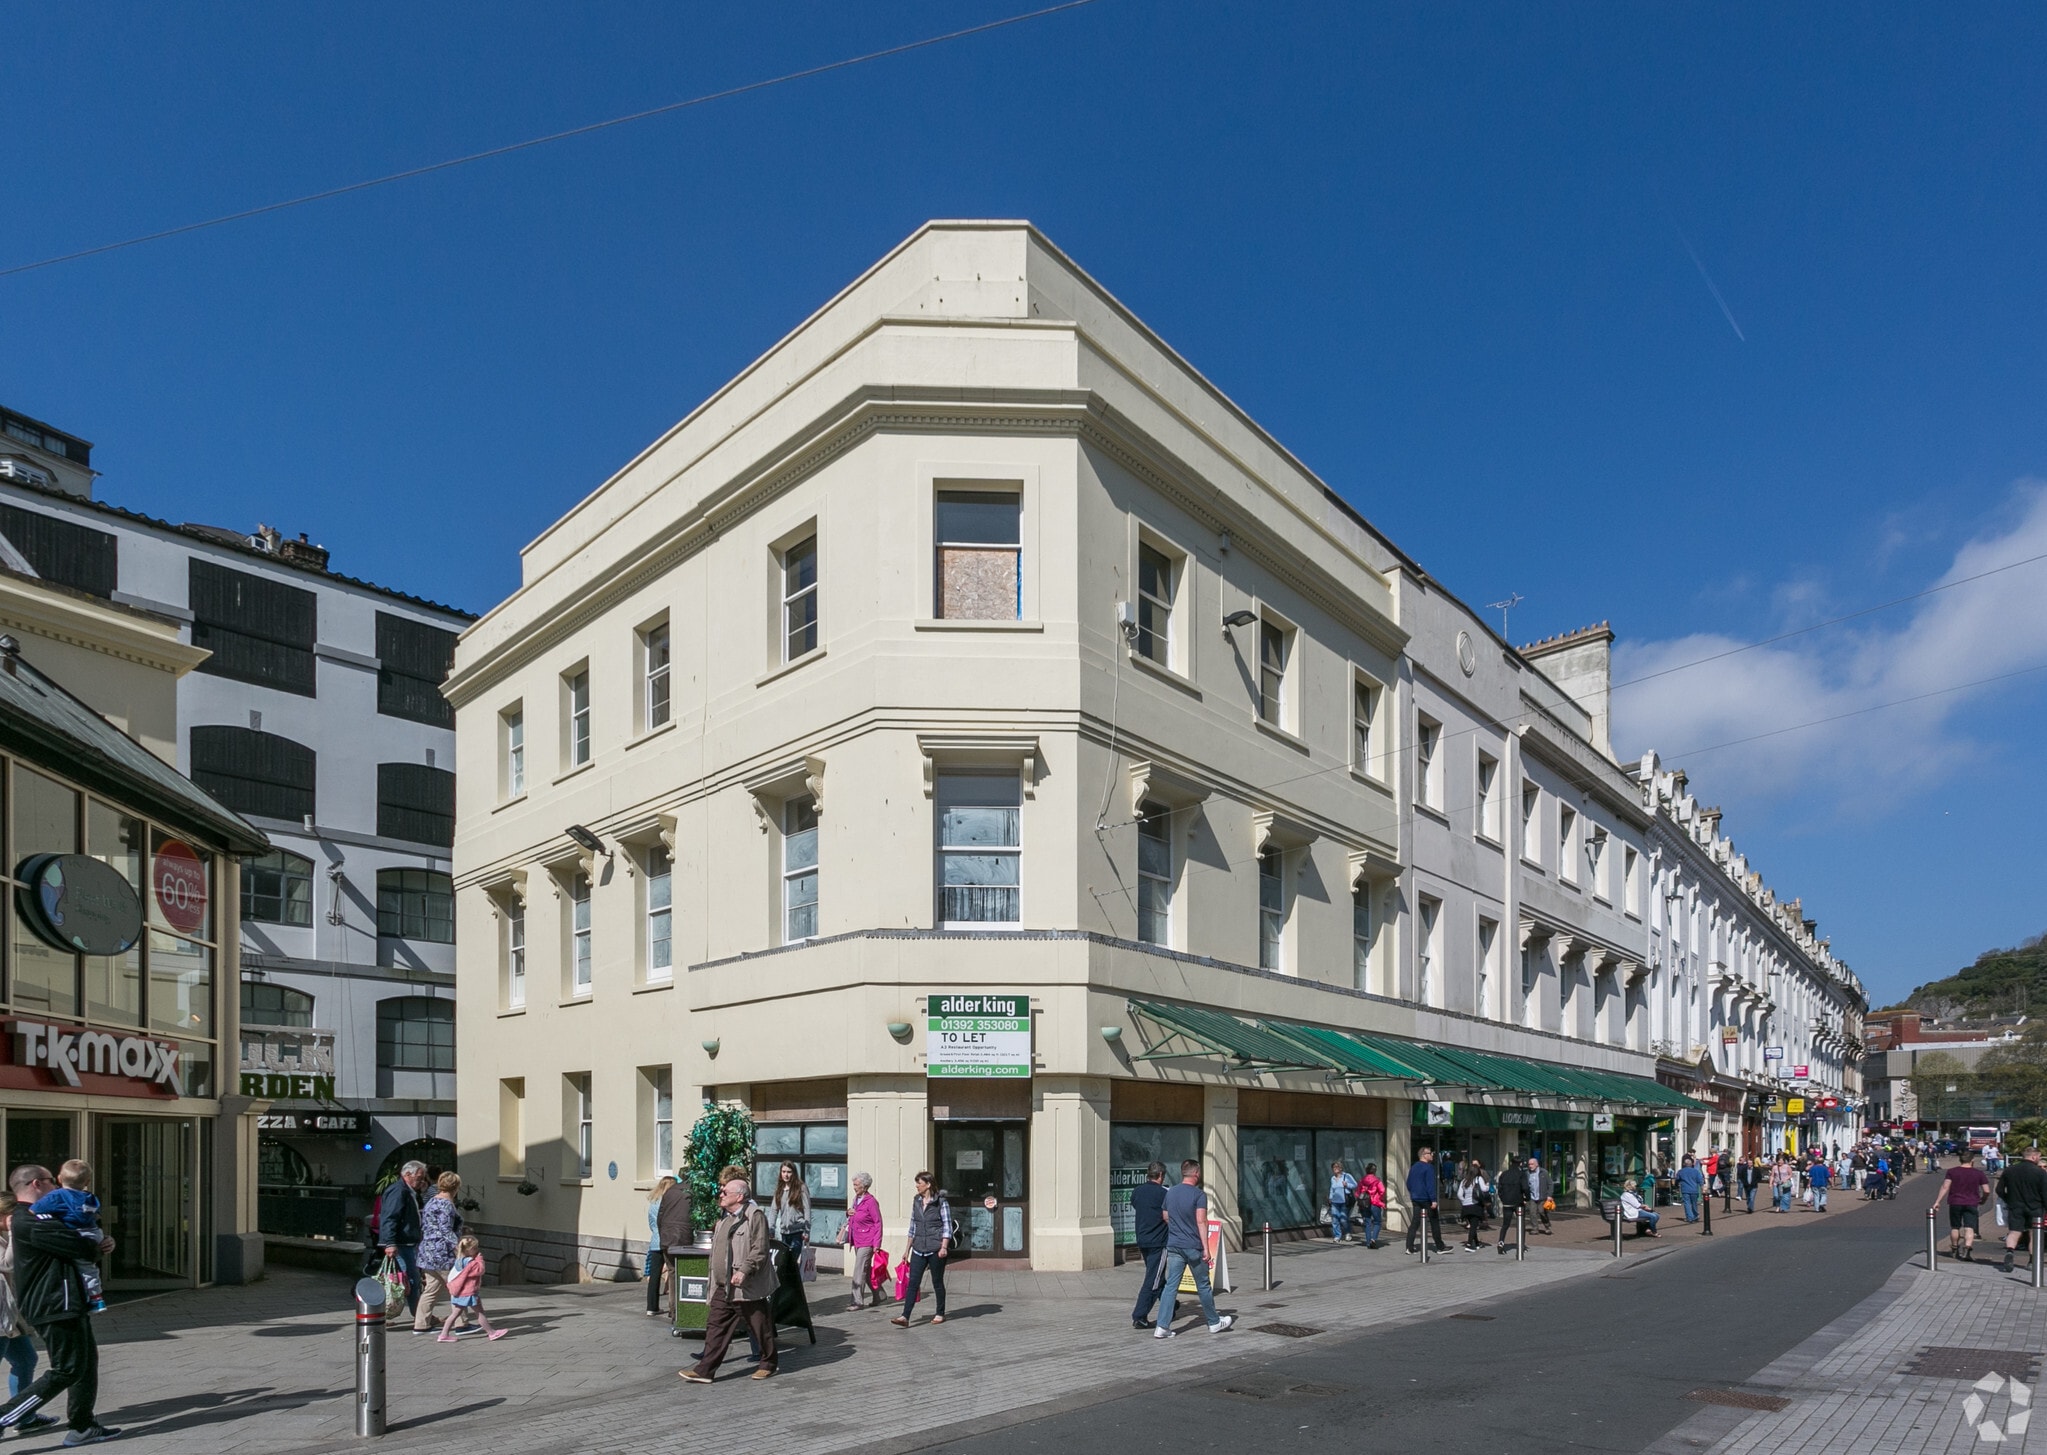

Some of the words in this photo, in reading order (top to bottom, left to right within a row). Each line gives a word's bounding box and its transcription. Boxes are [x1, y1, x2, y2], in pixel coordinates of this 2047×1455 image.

[162, 858, 183, 874] always
[184, 868, 192, 878] up
[193, 870, 200, 880] to
[162, 872, 201, 910] 60%
[188, 901, 201, 915] less
[941, 996, 980, 1012] alder
[983, 996, 1015, 1016] king
[941, 1020, 973, 1030] 01392
[977, 1020, 1018, 1030] 353080
[941, 1032, 958, 1043] TO
[963, 1032, 987, 1043] LET
[941, 1066, 1019, 1076] alderking.com
[317, 1116, 357, 1130] CAFE
